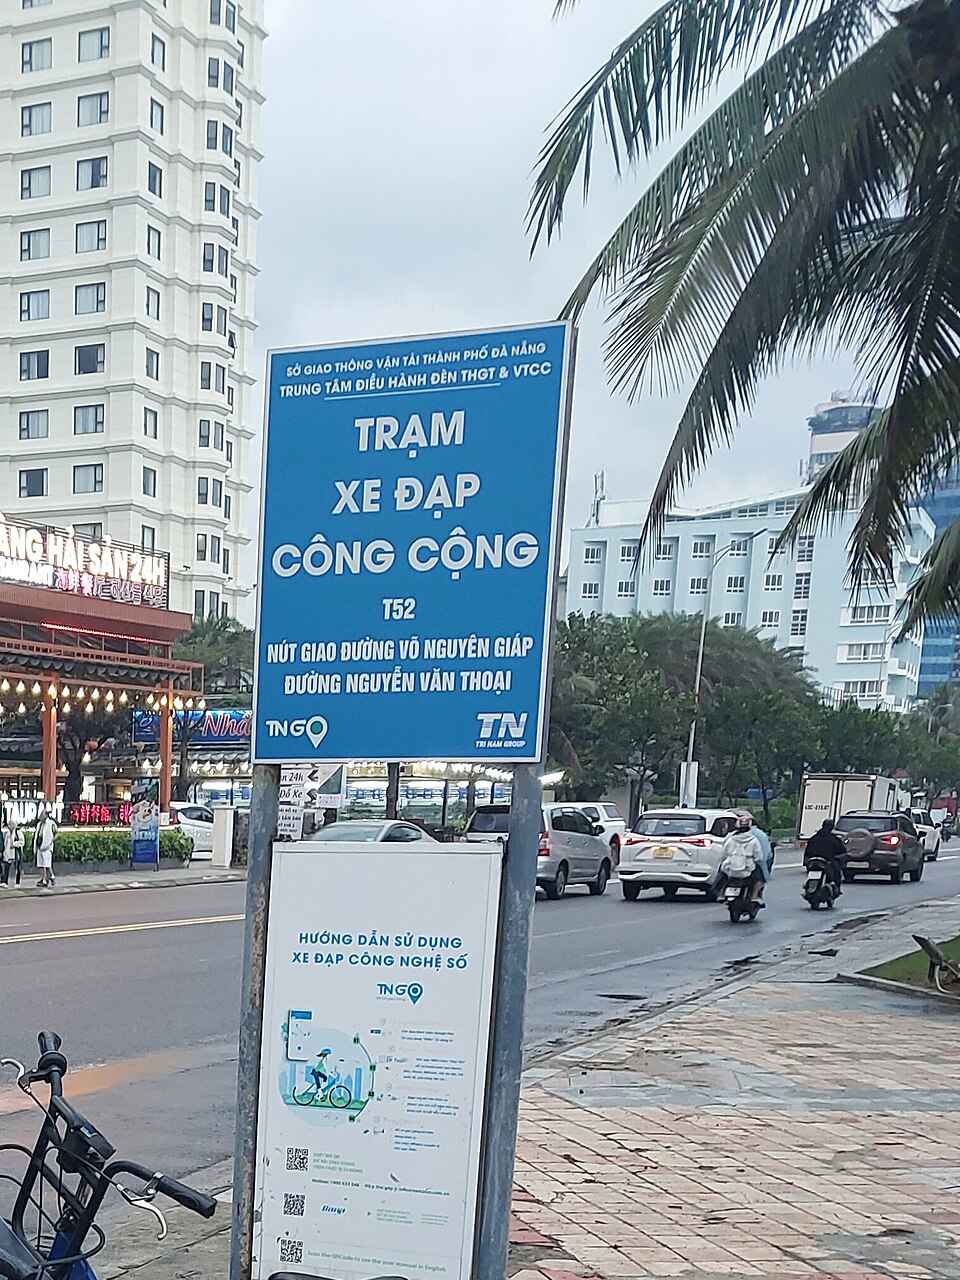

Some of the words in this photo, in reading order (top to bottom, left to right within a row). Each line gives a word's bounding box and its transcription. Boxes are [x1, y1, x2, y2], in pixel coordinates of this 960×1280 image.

[286, 364, 302, 377] SỞ
[304, 362, 332, 376] GIAO
[335, 360, 373, 374] THÔNG
[376, 355, 400, 372] VẬN
[402, 351, 420, 366] TẢI
[423, 349, 460, 365] THÀNH
[463, 344, 488, 361] PHỐ
[491, 343, 508, 358] ĐÀ
[511, 339, 547, 356] NẴNG
[279, 382, 322, 398] TRUNG
[324, 374, 352, 394] TÂM
[355, 370, 384, 391] ĐIỀU
[389, 368, 427, 389] HÀNH
[430, 366, 457, 386] ĐÈN
[461, 366, 495, 382] THGT
[498, 367, 509, 380] &
[513, 361, 552, 377] VTCC
[354, 410, 465, 458] TRẠM
[332, 478, 381, 515] XE
[394, 473, 481, 519] ĐẠP
[46, 525, 85, 573] HẢI
[89, 534, 131, 580] SẢN
[131, 551, 166, 585] 24H
[271, 533, 395, 577] CÔNG
[408, 526, 539, 580] CỘNG
[382, 597, 416, 620] T52
[267, 637, 297, 664] NÚT
[300, 641, 337, 662] GIAO
[340, 636, 394, 661] ĐƯỜNG
[399, 636, 420, 660] VÕ
[423, 634, 490, 660] NGUYÊN
[494, 632, 534, 658] GIÁP
[284, 670, 341, 695] ĐƯỜNG
[346, 665, 415, 694] NGUYỄN
[420, 669, 455, 692] VĂN
[460, 670, 512, 696] THOẠI
[476, 712, 528, 739] TN
[504, 740, 526, 748] GROUP
[292, 789, 303, 799] Xe
[299, 930, 353, 945] HƯỚNG
[357, 929, 390, 946] DẪN
[394, 932, 414, 947] SỬ
[417, 936, 463, 951] DỤNG
[292, 952, 310, 963] XE
[314, 952, 344, 967] ĐẠP
[348, 951, 395, 967] CÔNG
[399, 954, 442, 971] NGHỆ
[446, 953, 469, 969] SỐ
